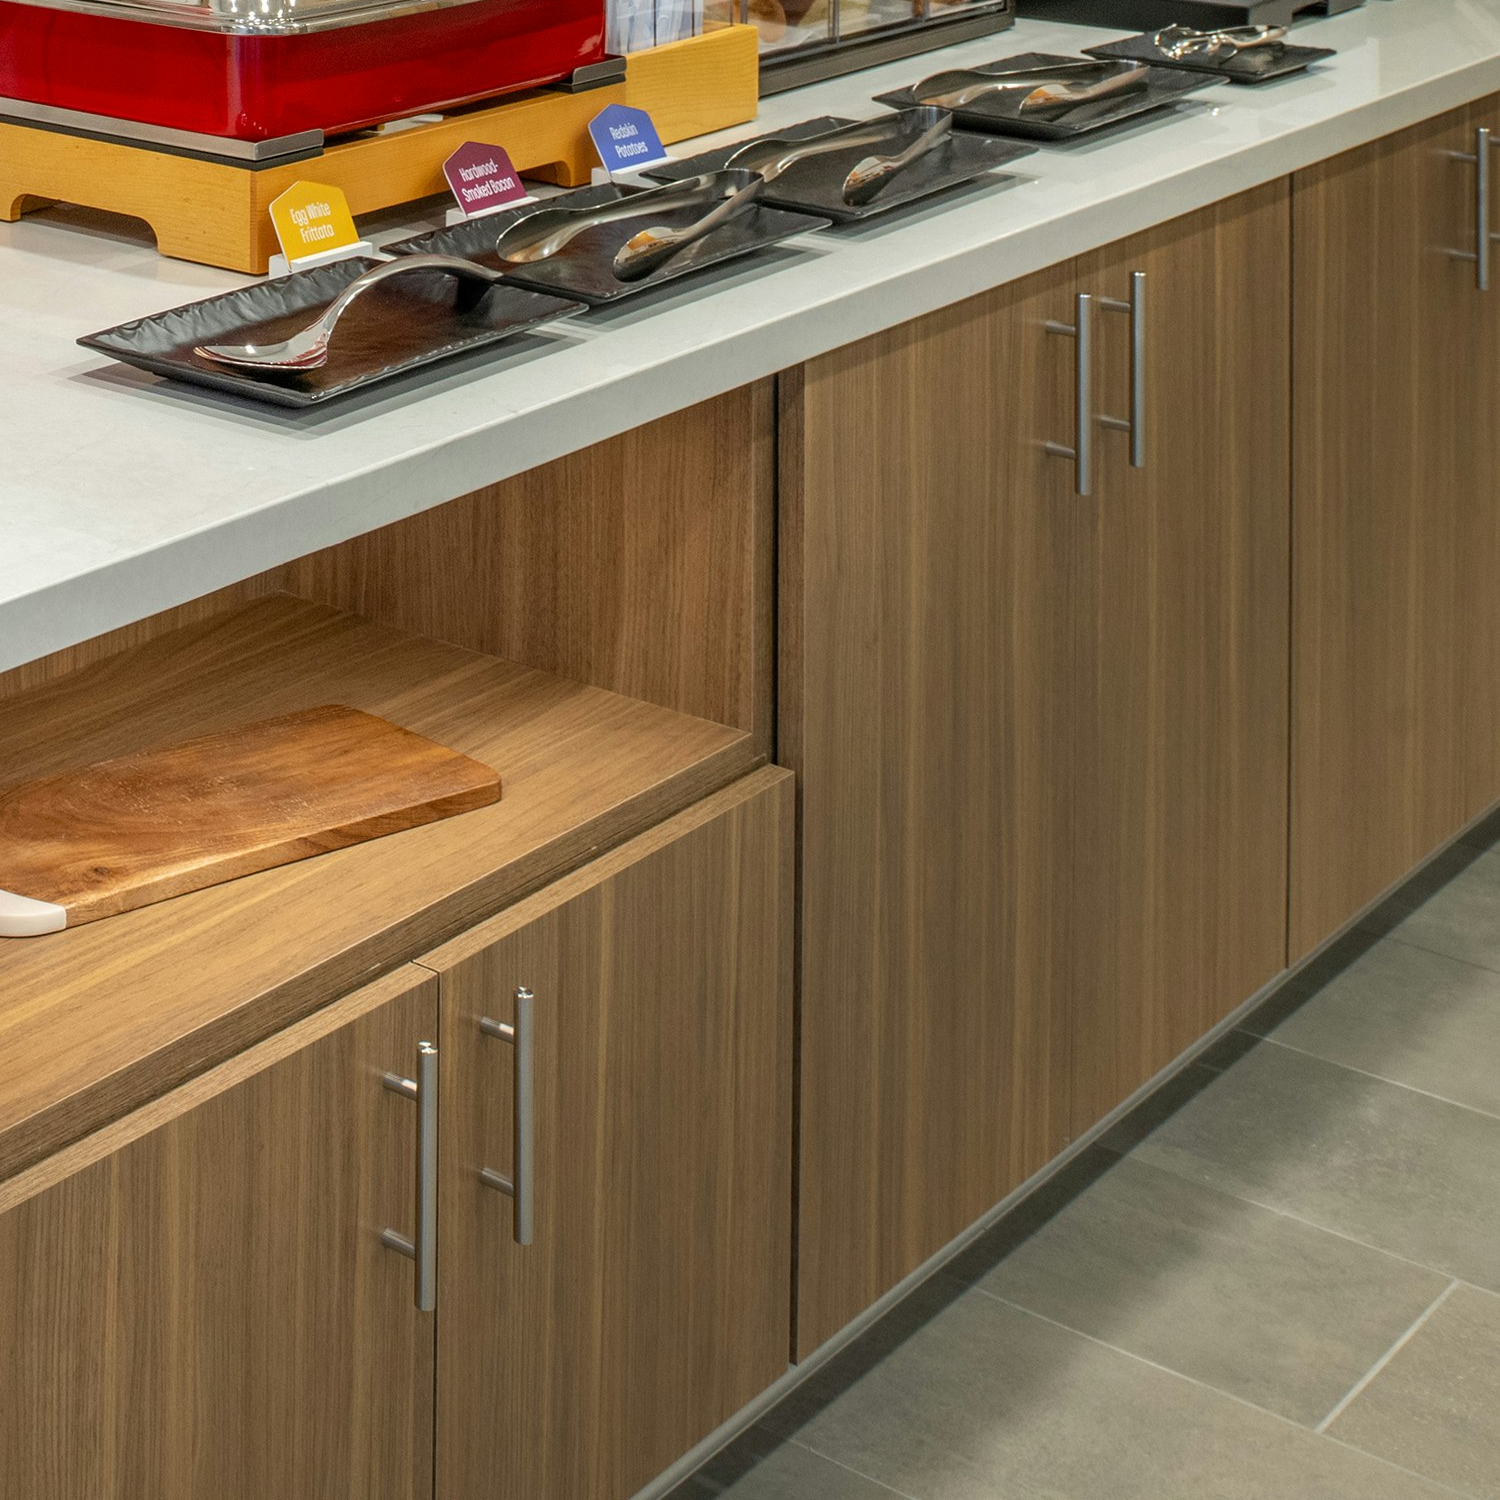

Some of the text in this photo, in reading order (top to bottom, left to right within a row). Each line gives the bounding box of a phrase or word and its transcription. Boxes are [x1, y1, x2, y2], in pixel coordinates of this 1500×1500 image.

[609, 122, 639, 141] Redskin
[615, 141, 648, 159] Potatoes
[458, 158, 498, 182] Hardwood-
[461, 177, 515, 203] Smoked Bacon
[289, 202, 331, 226] Egg White
[299, 224, 335, 244] Frittata
